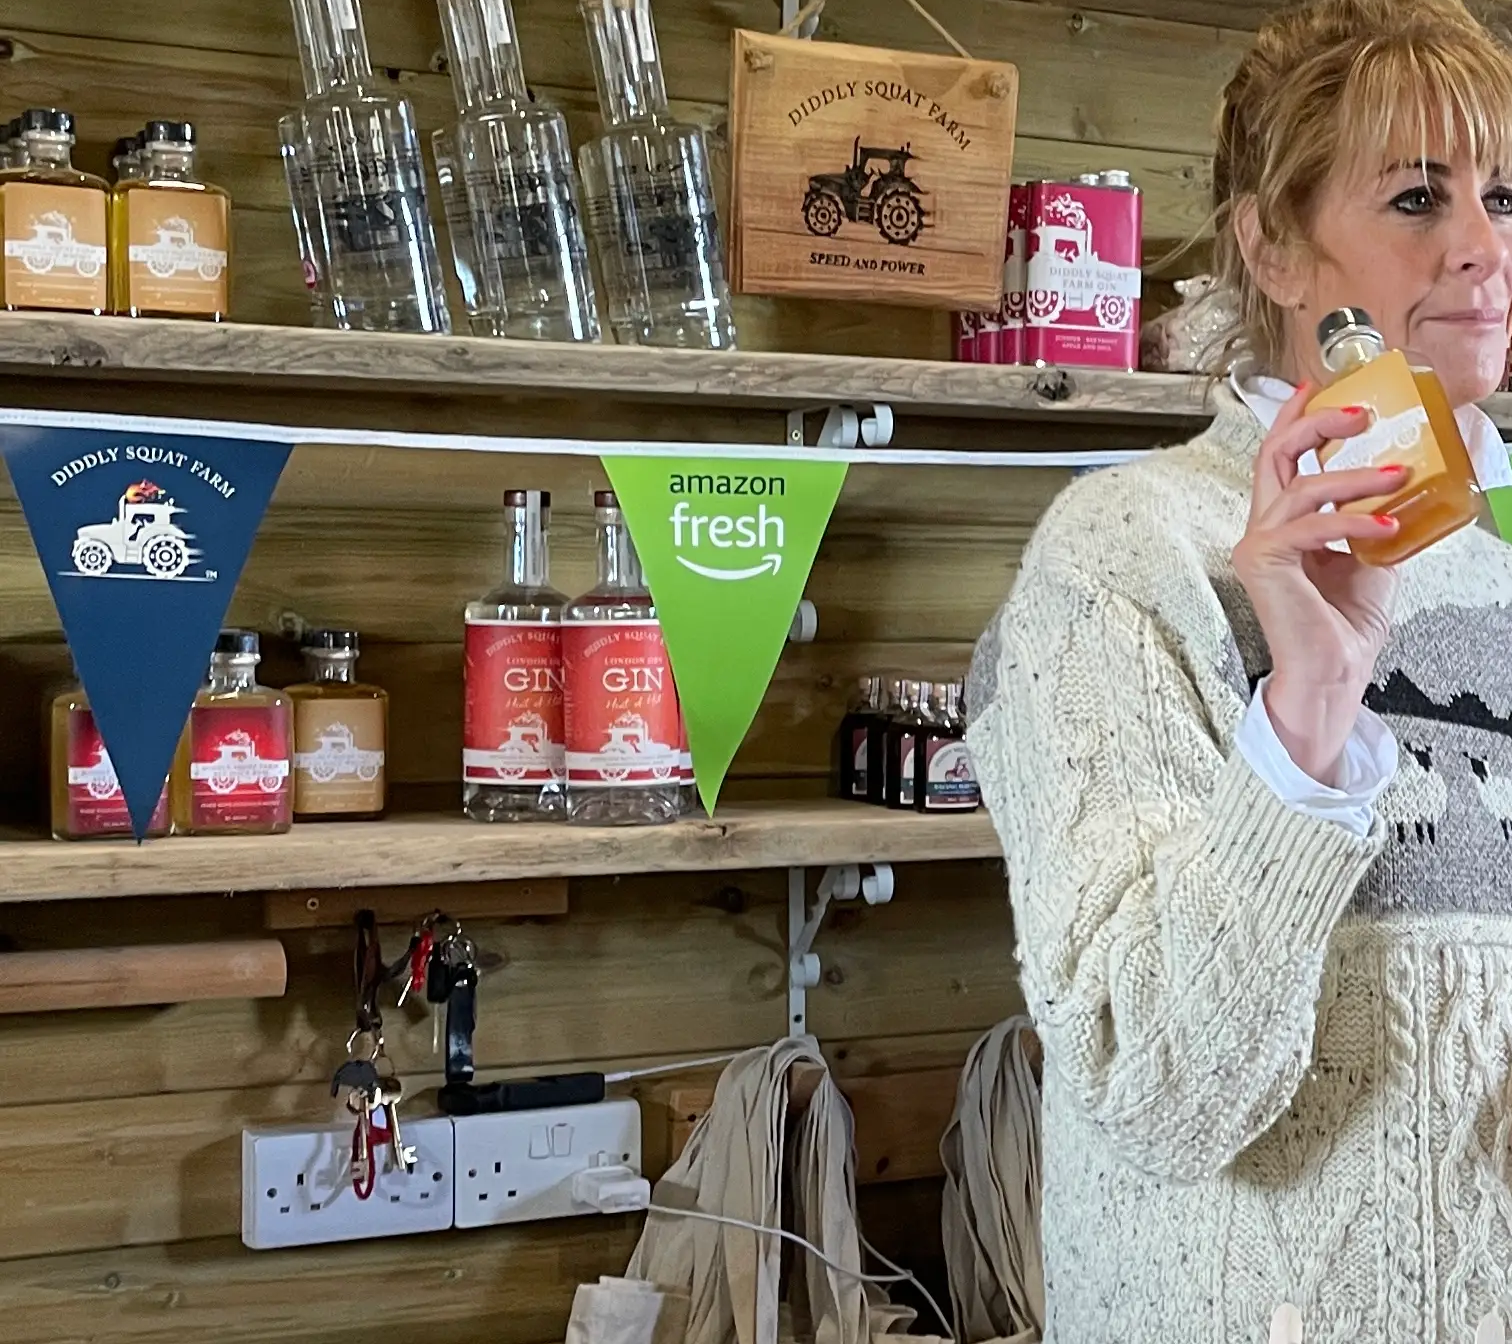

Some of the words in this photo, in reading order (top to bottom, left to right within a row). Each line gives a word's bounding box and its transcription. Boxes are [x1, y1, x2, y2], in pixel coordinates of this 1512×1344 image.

[787, 80, 858, 127] DIDDLY
[864, 80, 927, 109] SQUAT
[928, 101, 972, 152] FARM
[809, 251, 852, 269] SPEED
[853, 257, 878, 273] AND
[880, 258, 926, 277] POWER
[1049, 266, 1093, 279] DIDDLY
[1062, 278, 1094, 290] FARM
[1096, 281, 1117, 292] GIN
[50, 446, 120, 487] DIDDLY
[125, 445, 188, 468] SQUAT
[189, 459, 236, 500] FARM
[669, 473, 786, 497] amazon
[668, 502, 785, 549] fresh
[485, 632, 524, 658] DIDDLY
[506, 656, 549, 667] LONDON
[603, 656, 646, 667] LONDON
[503, 666, 566, 693] GIN
[602, 666, 665, 693] GIN
